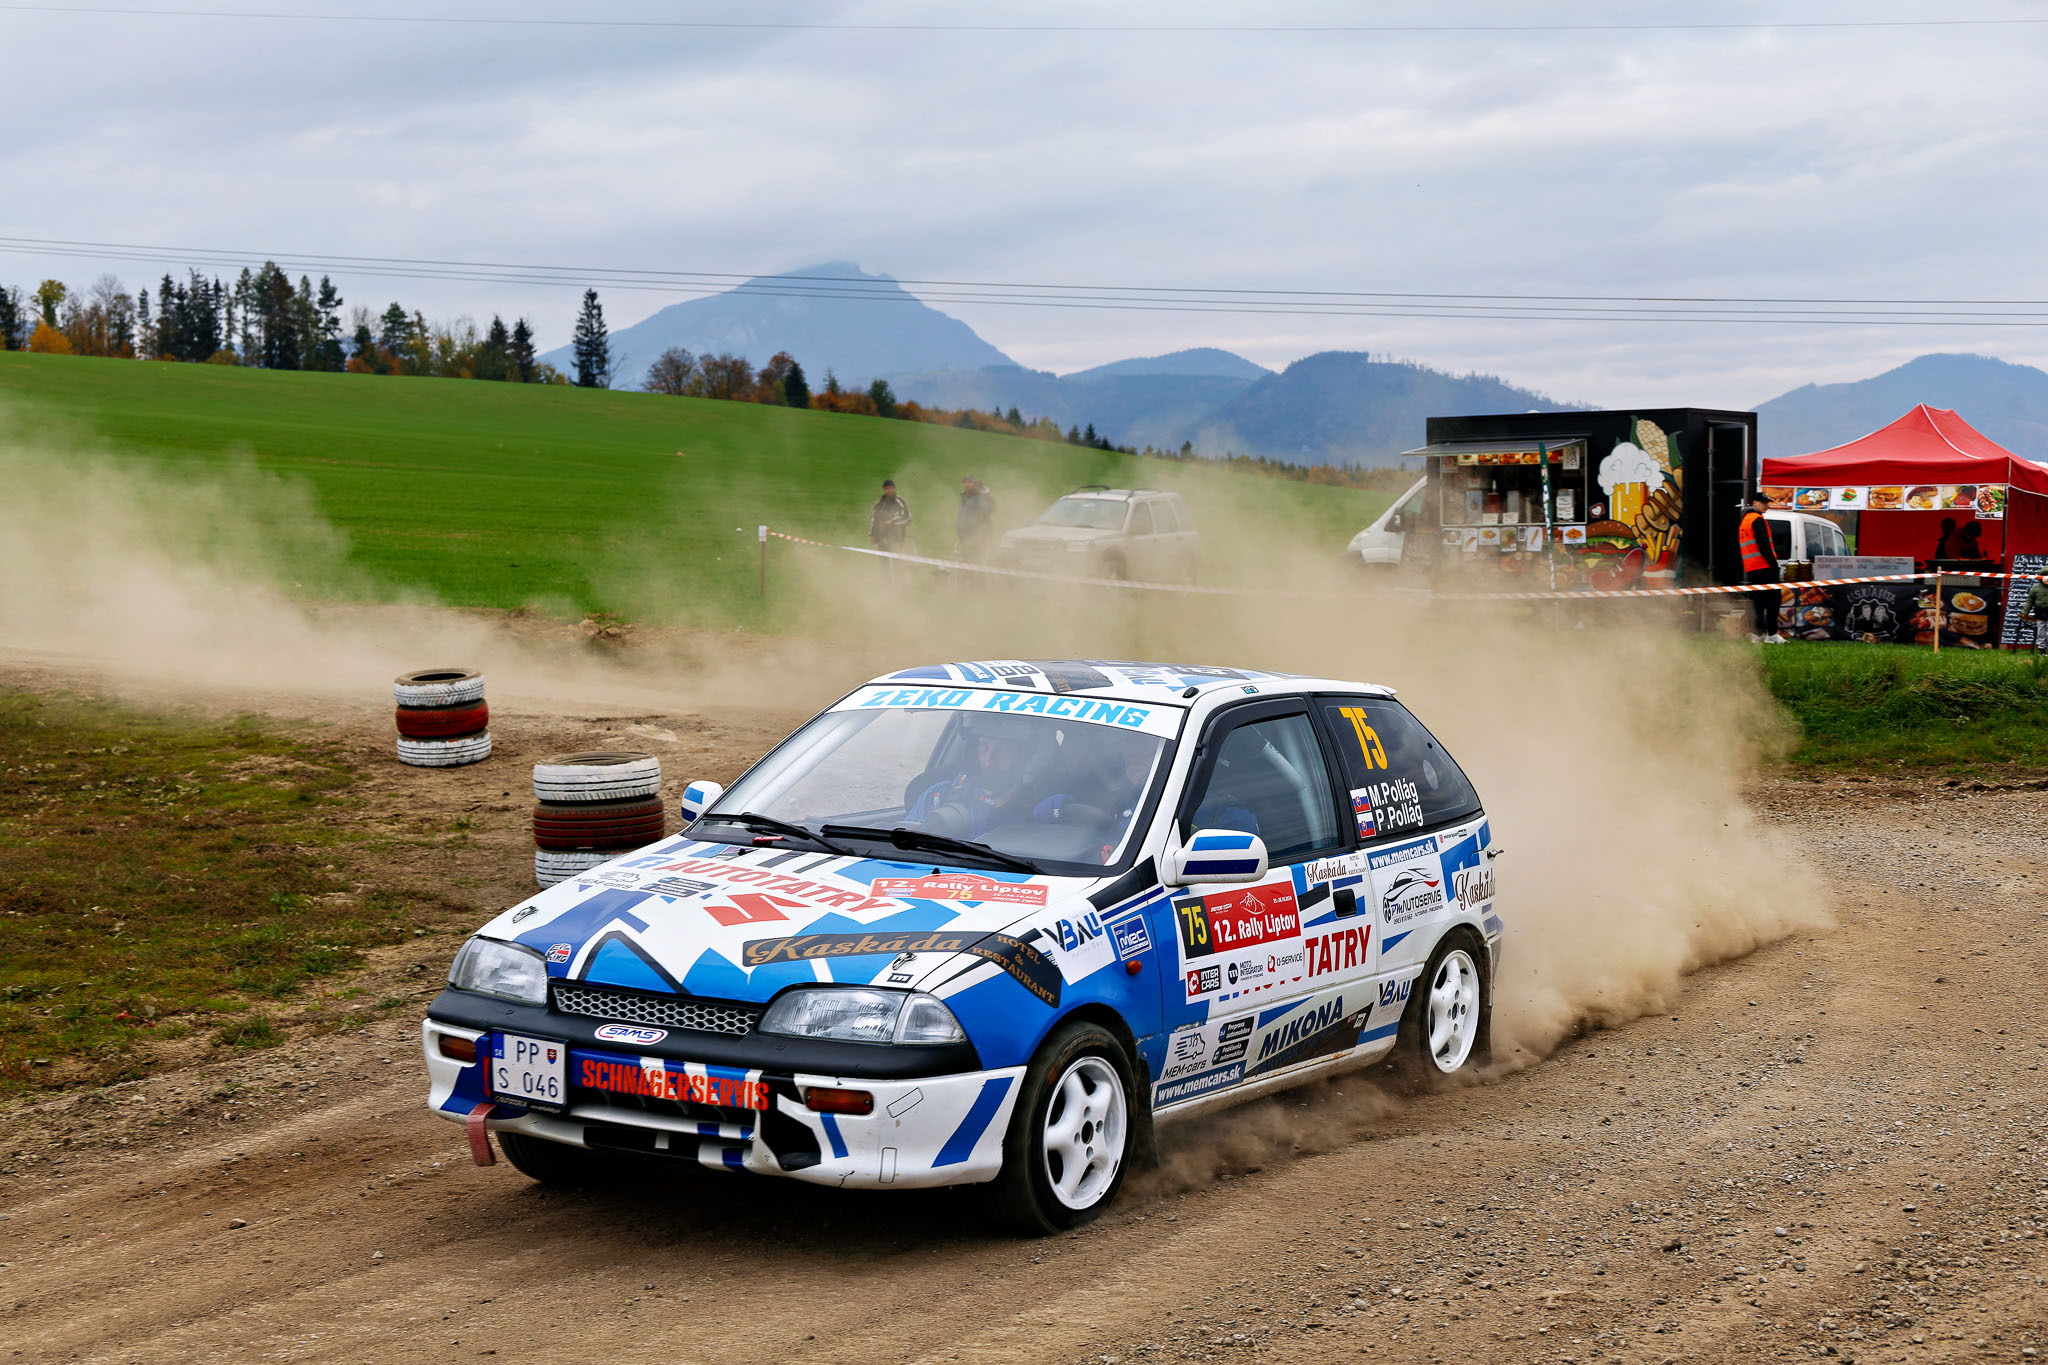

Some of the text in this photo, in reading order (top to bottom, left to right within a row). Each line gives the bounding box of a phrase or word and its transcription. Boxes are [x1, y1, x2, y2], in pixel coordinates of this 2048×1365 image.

[859, 690, 1150, 727] ZEKO RACING
[1339, 707, 1388, 770] 75
[1367, 778, 1419, 808] M.Pollág
[1371, 840, 1435, 869] www.memcars.sk
[1307, 859, 1347, 883] Kaskáda
[652, 860, 897, 913] AUTOTATRY
[877, 880, 1044, 896] 12. Rally Liptov
[946, 890, 973, 899] 75
[1181, 905, 1208, 946] 75
[1213, 913, 1297, 944] 12. Rally Liptov
[746, 934, 965, 966] Kaskáda
[996, 935, 1041, 965] HOTEL
[1014, 953, 1024, 965] &
[1303, 925, 1371, 978] TATRY
[972, 947, 1055, 1003] RESTAURANT
[1200, 968, 1220, 981] INTER
[1201, 978, 1220, 991] CARS
[605, 1027, 657, 1039] SAMS
[1257, 995, 1343, 1062] MIKONA
[516, 1040, 540, 1064] PP
[498, 1067, 558, 1099] S 046
[1158, 1064, 1241, 1102] www.memcars.sk
[1163, 1060, 1207, 1080] MEM-cars
